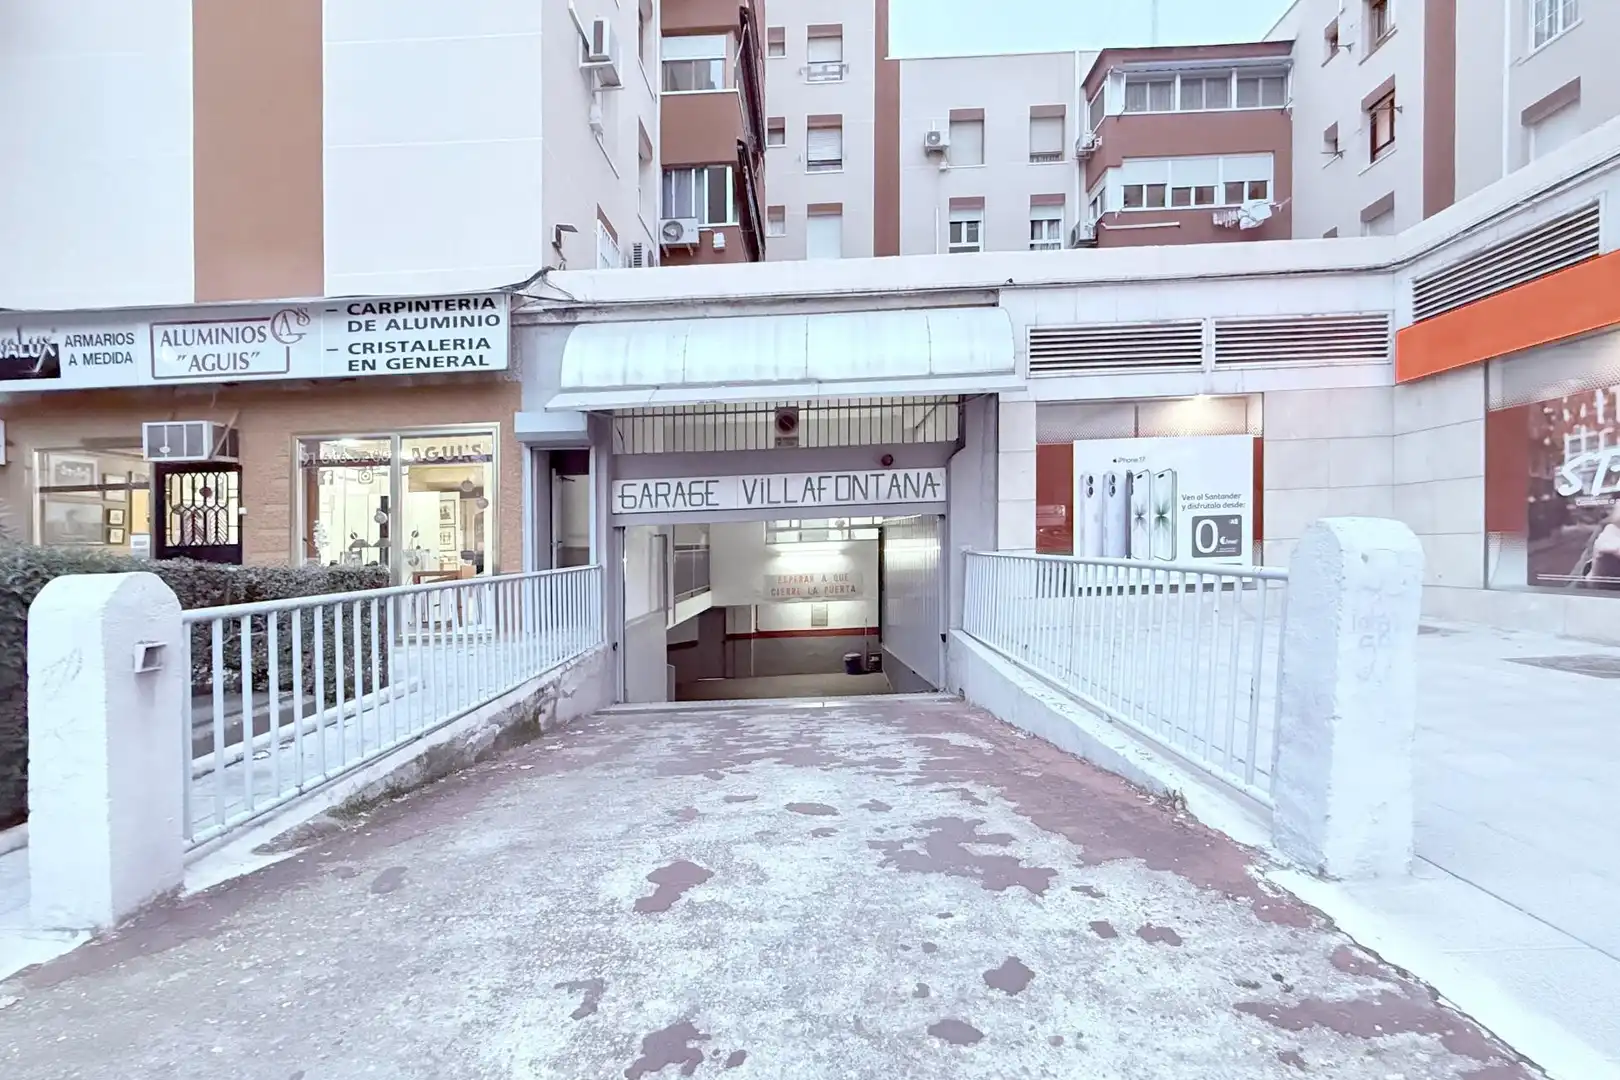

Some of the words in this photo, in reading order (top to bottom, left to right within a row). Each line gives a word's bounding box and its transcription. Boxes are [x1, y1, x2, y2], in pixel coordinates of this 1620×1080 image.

[347, 297, 497, 316] CARPINTERIA
[347, 319, 377, 333] DE
[385, 314, 501, 332] ALUMINIO
[64, 332, 135, 349] ARMARIOS
[160, 325, 267, 348] ALUMINIOS
[347, 337, 492, 355] CRISTALERIA
[68, 352, 78, 367] A
[83, 351, 134, 366] MEDIDA
[347, 359, 377, 372] EN
[386, 354, 490, 370] GENERAL
[618, 480, 720, 510] GARAGE
[1181, 493, 1196, 501] Ven
[1204, 492, 1243, 501] Santander
[1195, 518, 1219, 554] 0
